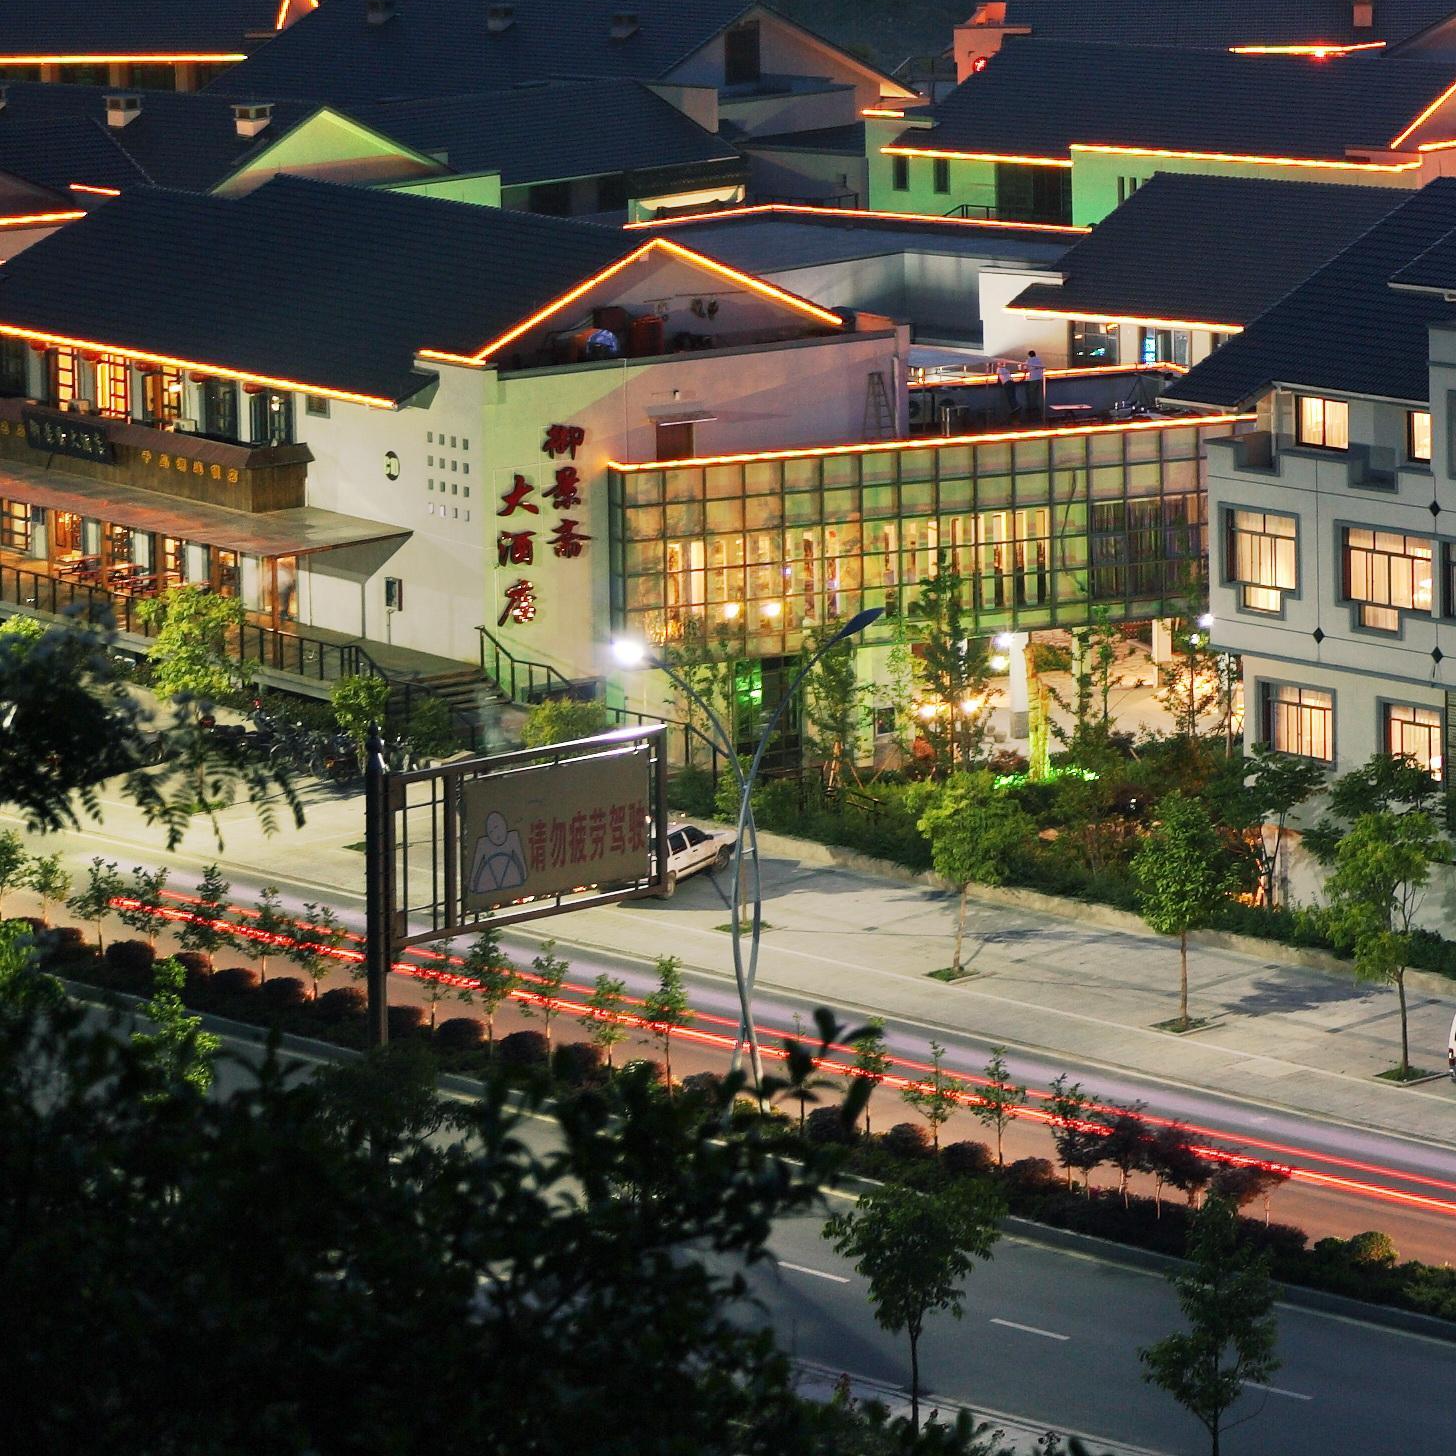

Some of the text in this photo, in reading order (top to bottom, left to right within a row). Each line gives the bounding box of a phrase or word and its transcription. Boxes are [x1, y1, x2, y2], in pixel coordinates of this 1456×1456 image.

[497, 473, 540, 627] 大酒店
[528, 801, 645, 873] 请勿疲劳驾驶
